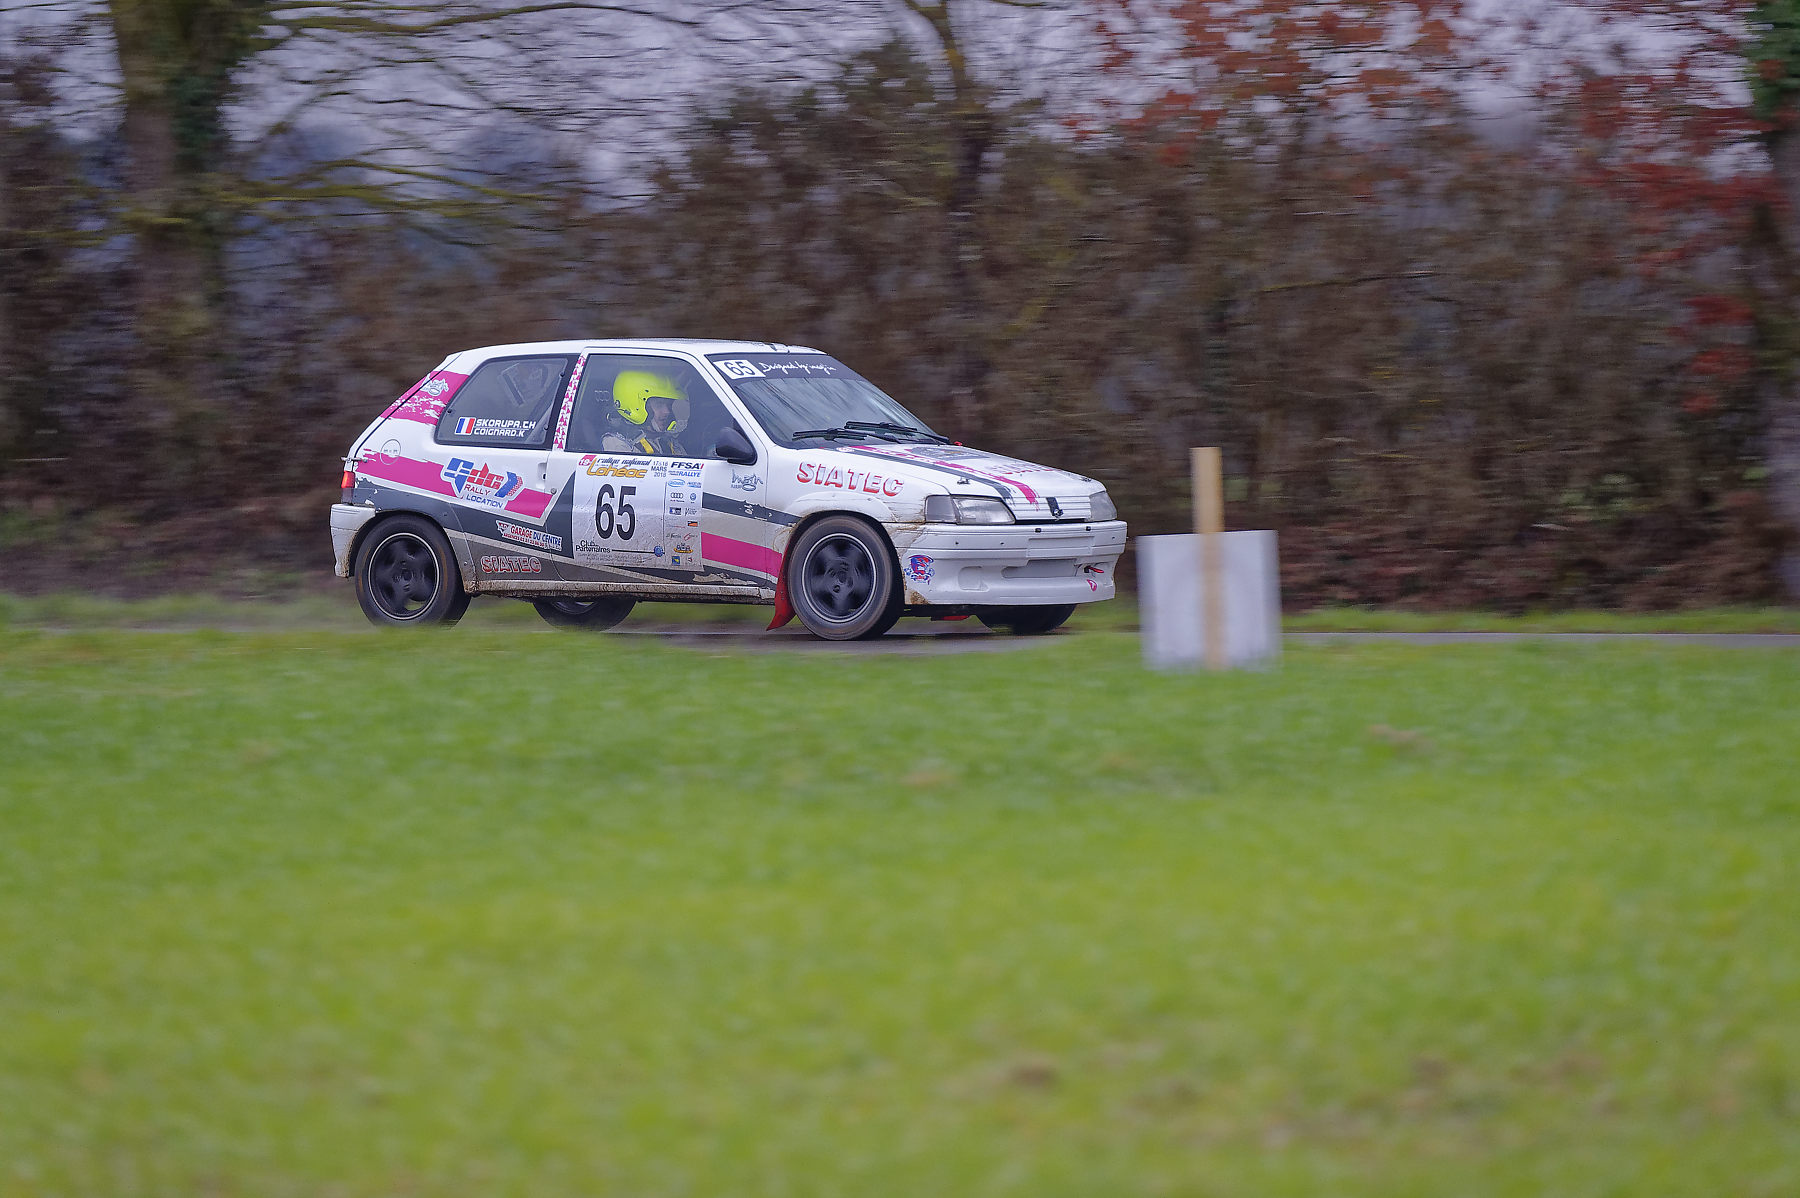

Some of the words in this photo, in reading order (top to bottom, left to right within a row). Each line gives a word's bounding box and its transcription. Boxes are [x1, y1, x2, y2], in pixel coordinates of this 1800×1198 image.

[724, 361, 755, 376] 65
[476, 418, 537, 429] SKORUPA.CH
[473, 428, 525, 438] COIGNARD.K
[586, 457, 648, 479] Lohéac
[671, 461, 700, 470] FFSA
[679, 470, 701, 478] RALLYE
[796, 461, 905, 497] SIATEC
[464, 483, 491, 496] RALLY
[466, 493, 504, 509] LOCATION
[595, 483, 637, 541] 65
[511, 525, 532, 539] GARAGE
[533, 531, 541, 541] DU
[541, 533, 561, 547] CENTRE
[575, 544, 611, 553] Partenaires
[481, 555, 542, 573] SIATEC
